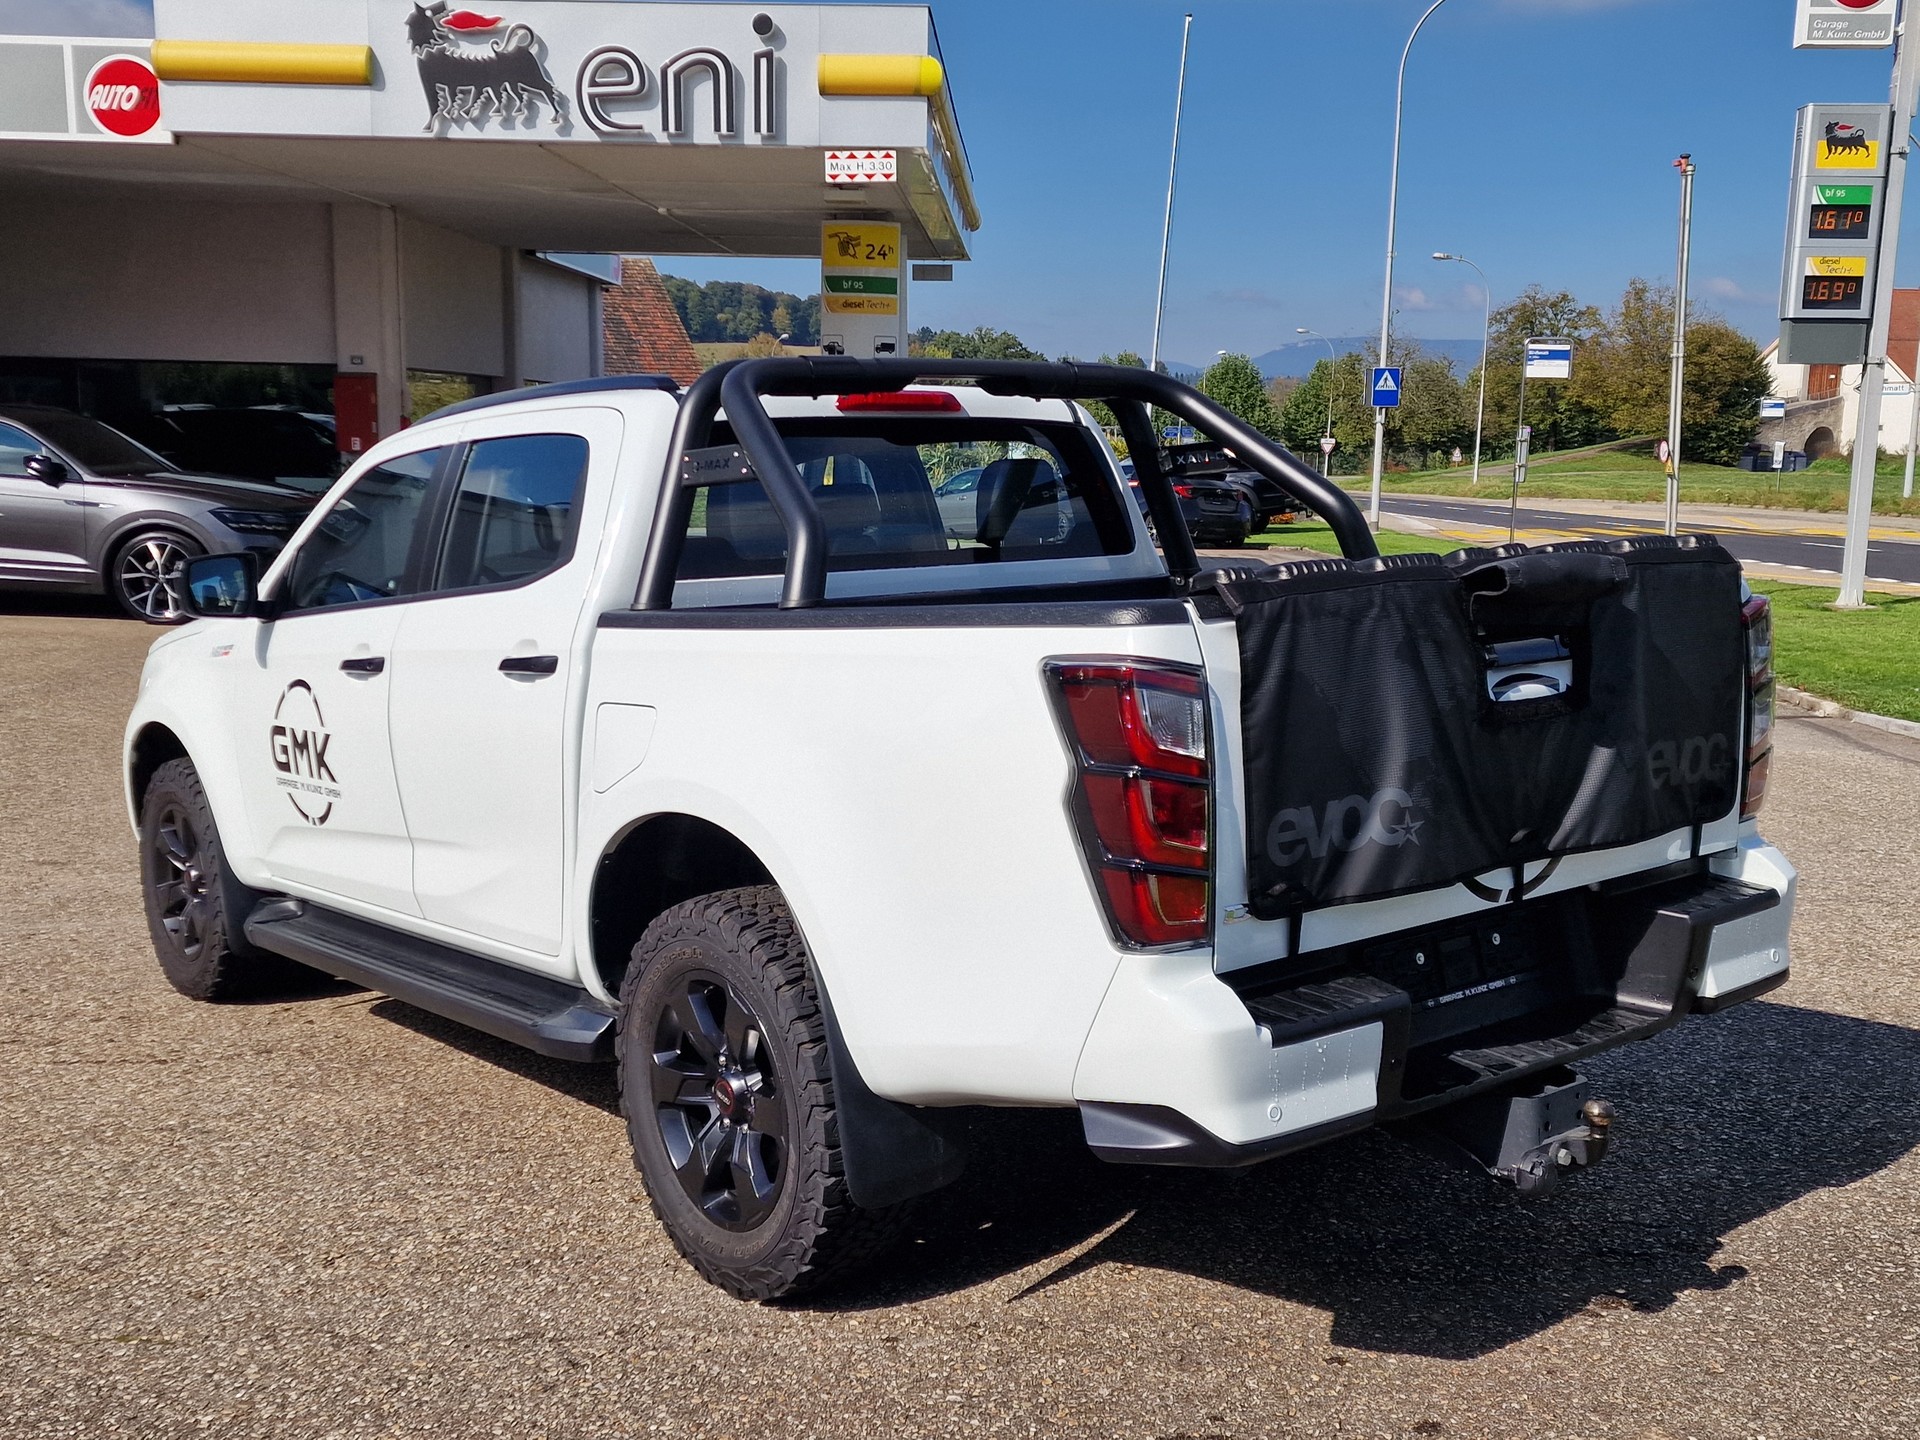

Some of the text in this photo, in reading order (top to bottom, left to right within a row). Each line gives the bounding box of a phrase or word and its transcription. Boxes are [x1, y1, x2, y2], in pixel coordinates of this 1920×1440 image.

[1813, 19, 1849, 29] Garage
[1812, 30, 1885, 39] M. Kunz GmbH
[575, 12, 774, 134] eni
[829, 161, 893, 172] Max H. 3.30
[1825, 188, 1846, 198] bf 95
[865, 243, 895, 261] 24h
[1819, 256, 1841, 265] diesel
[842, 280, 864, 290] bf 95
[842, 300, 865, 309] diesel
[269, 724, 339, 784] GMK
[1267, 787, 1413, 868] evoc
